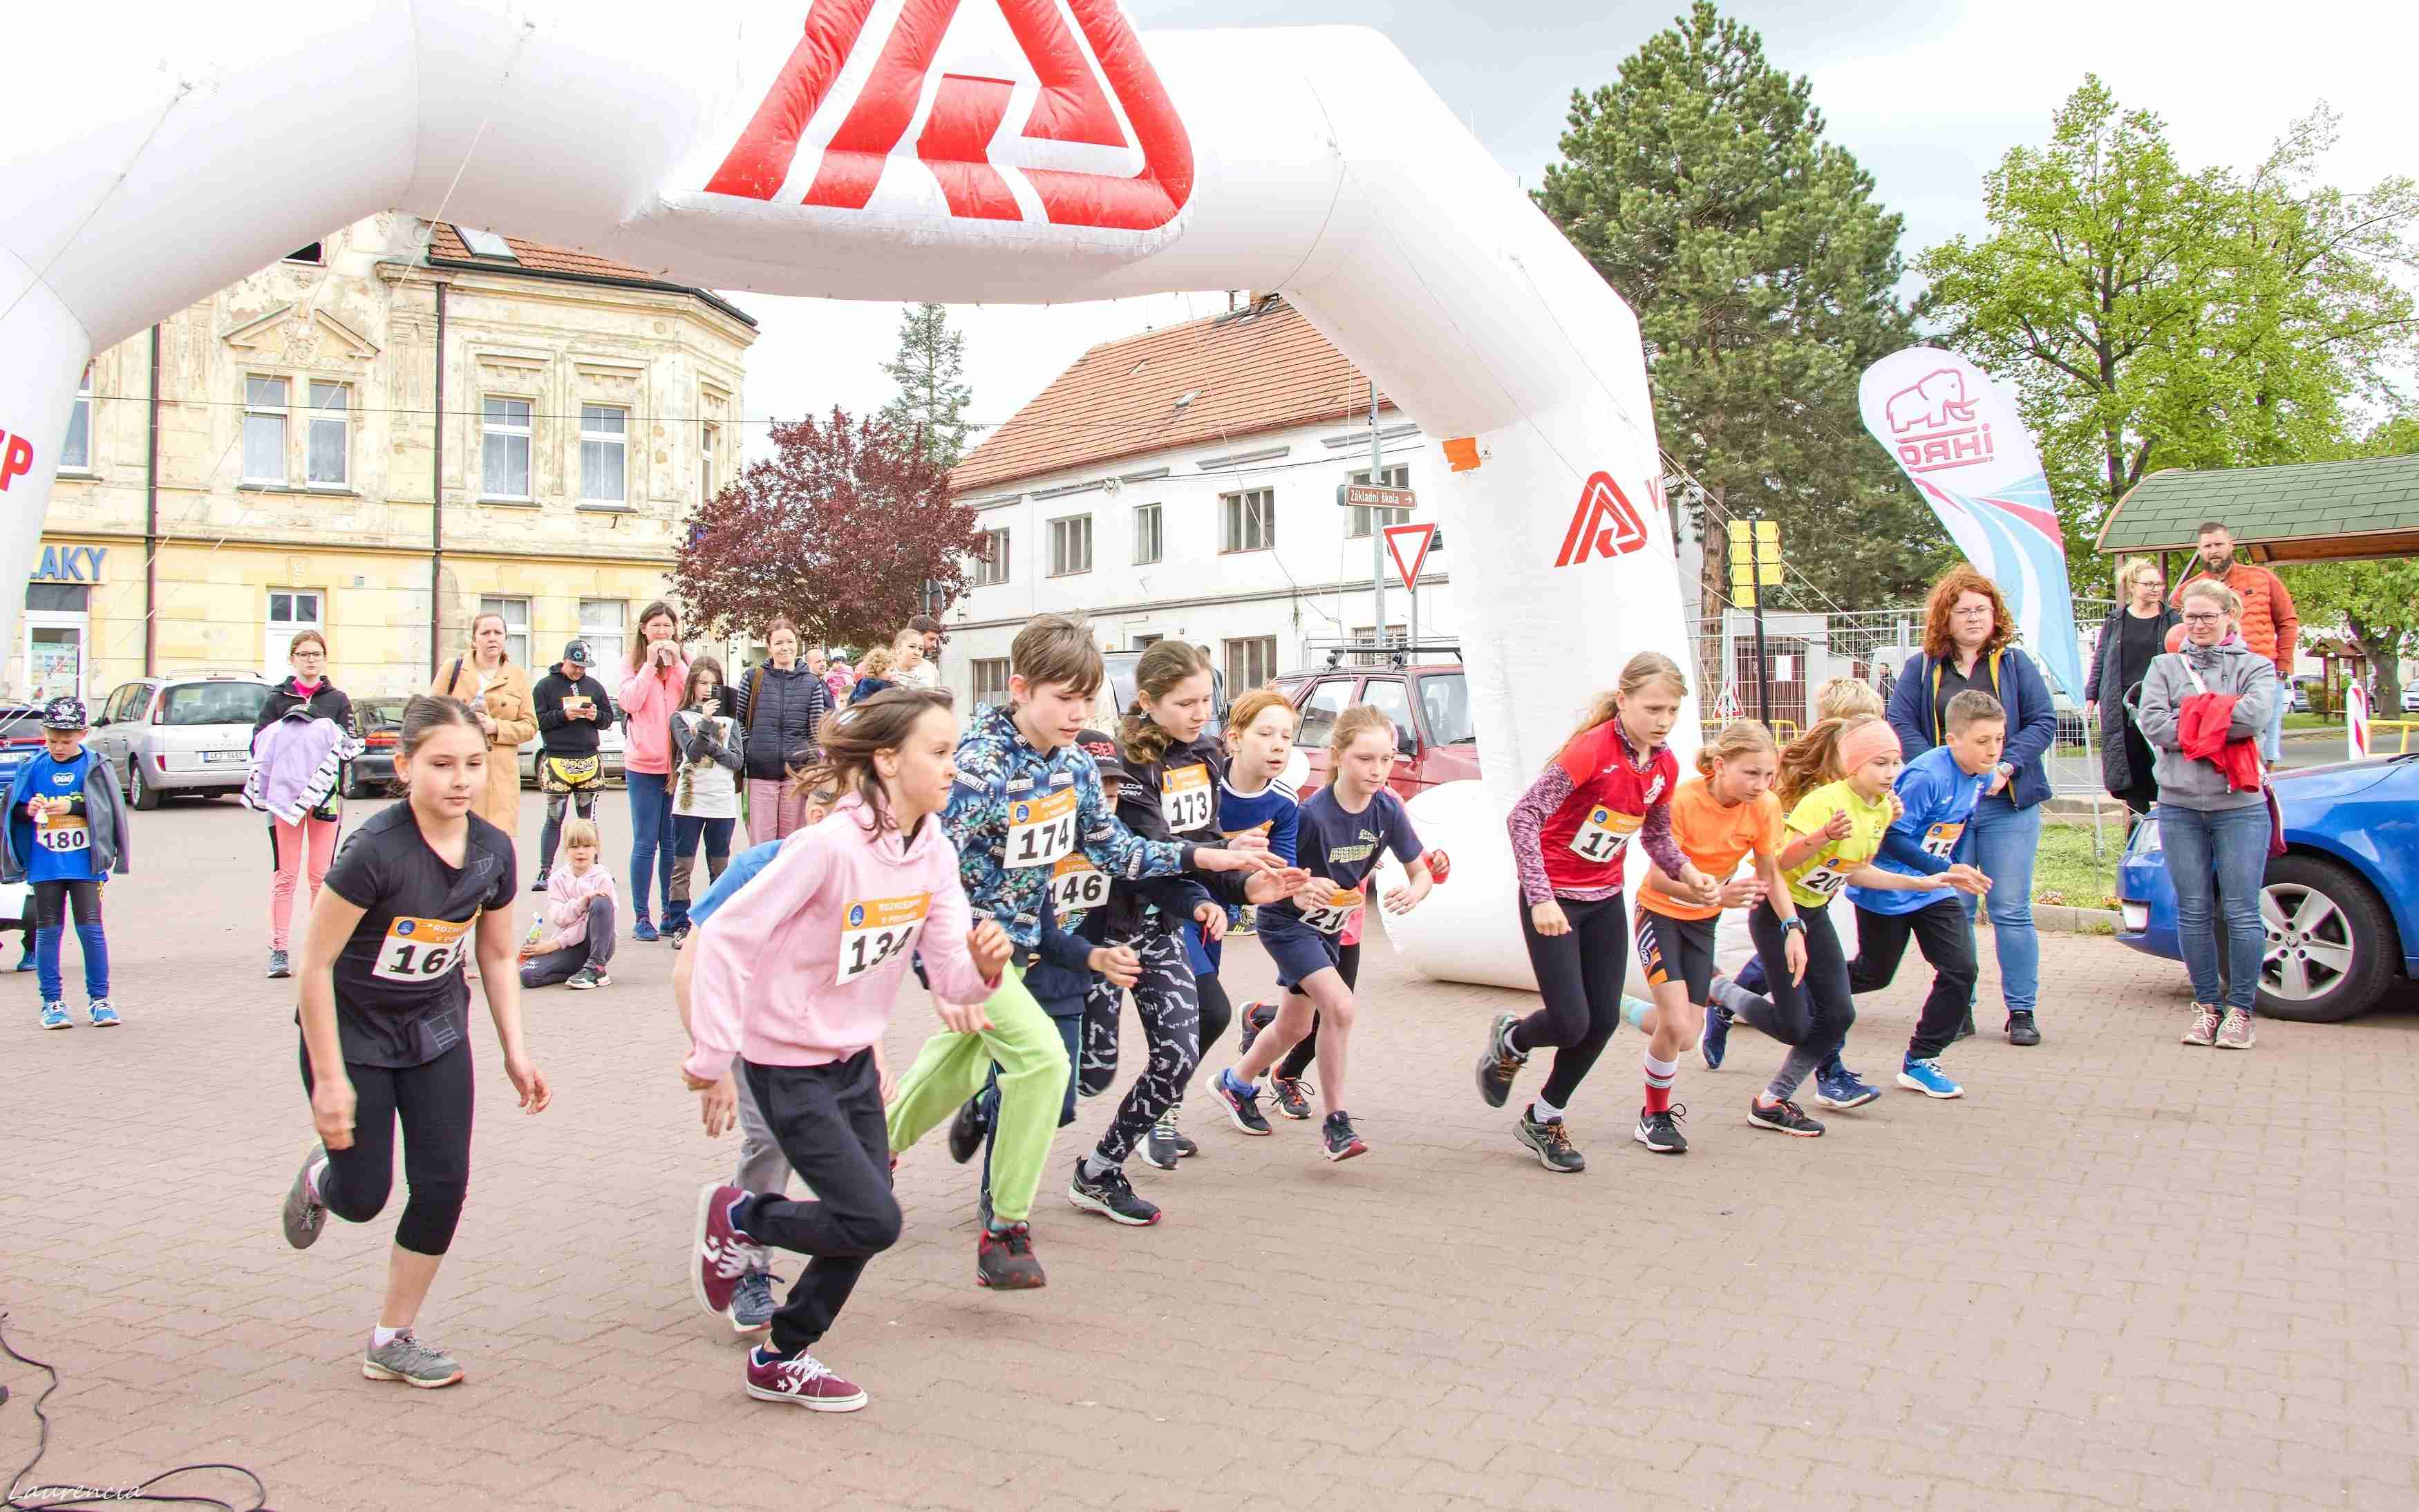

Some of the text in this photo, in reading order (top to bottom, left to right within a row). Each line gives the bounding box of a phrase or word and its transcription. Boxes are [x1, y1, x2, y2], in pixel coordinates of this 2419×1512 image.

[0, 428, 34, 491] P
[1350, 489, 1400, 504] Základní škola
[30, 546, 108, 580] AKY
[1171, 792, 1207, 826] 173
[44, 831, 84, 849] 180
[1018, 818, 1068, 860] 174
[1581, 832, 1629, 859] 17
[1807, 871, 1847, 892] 20
[848, 926, 913, 974] 134
